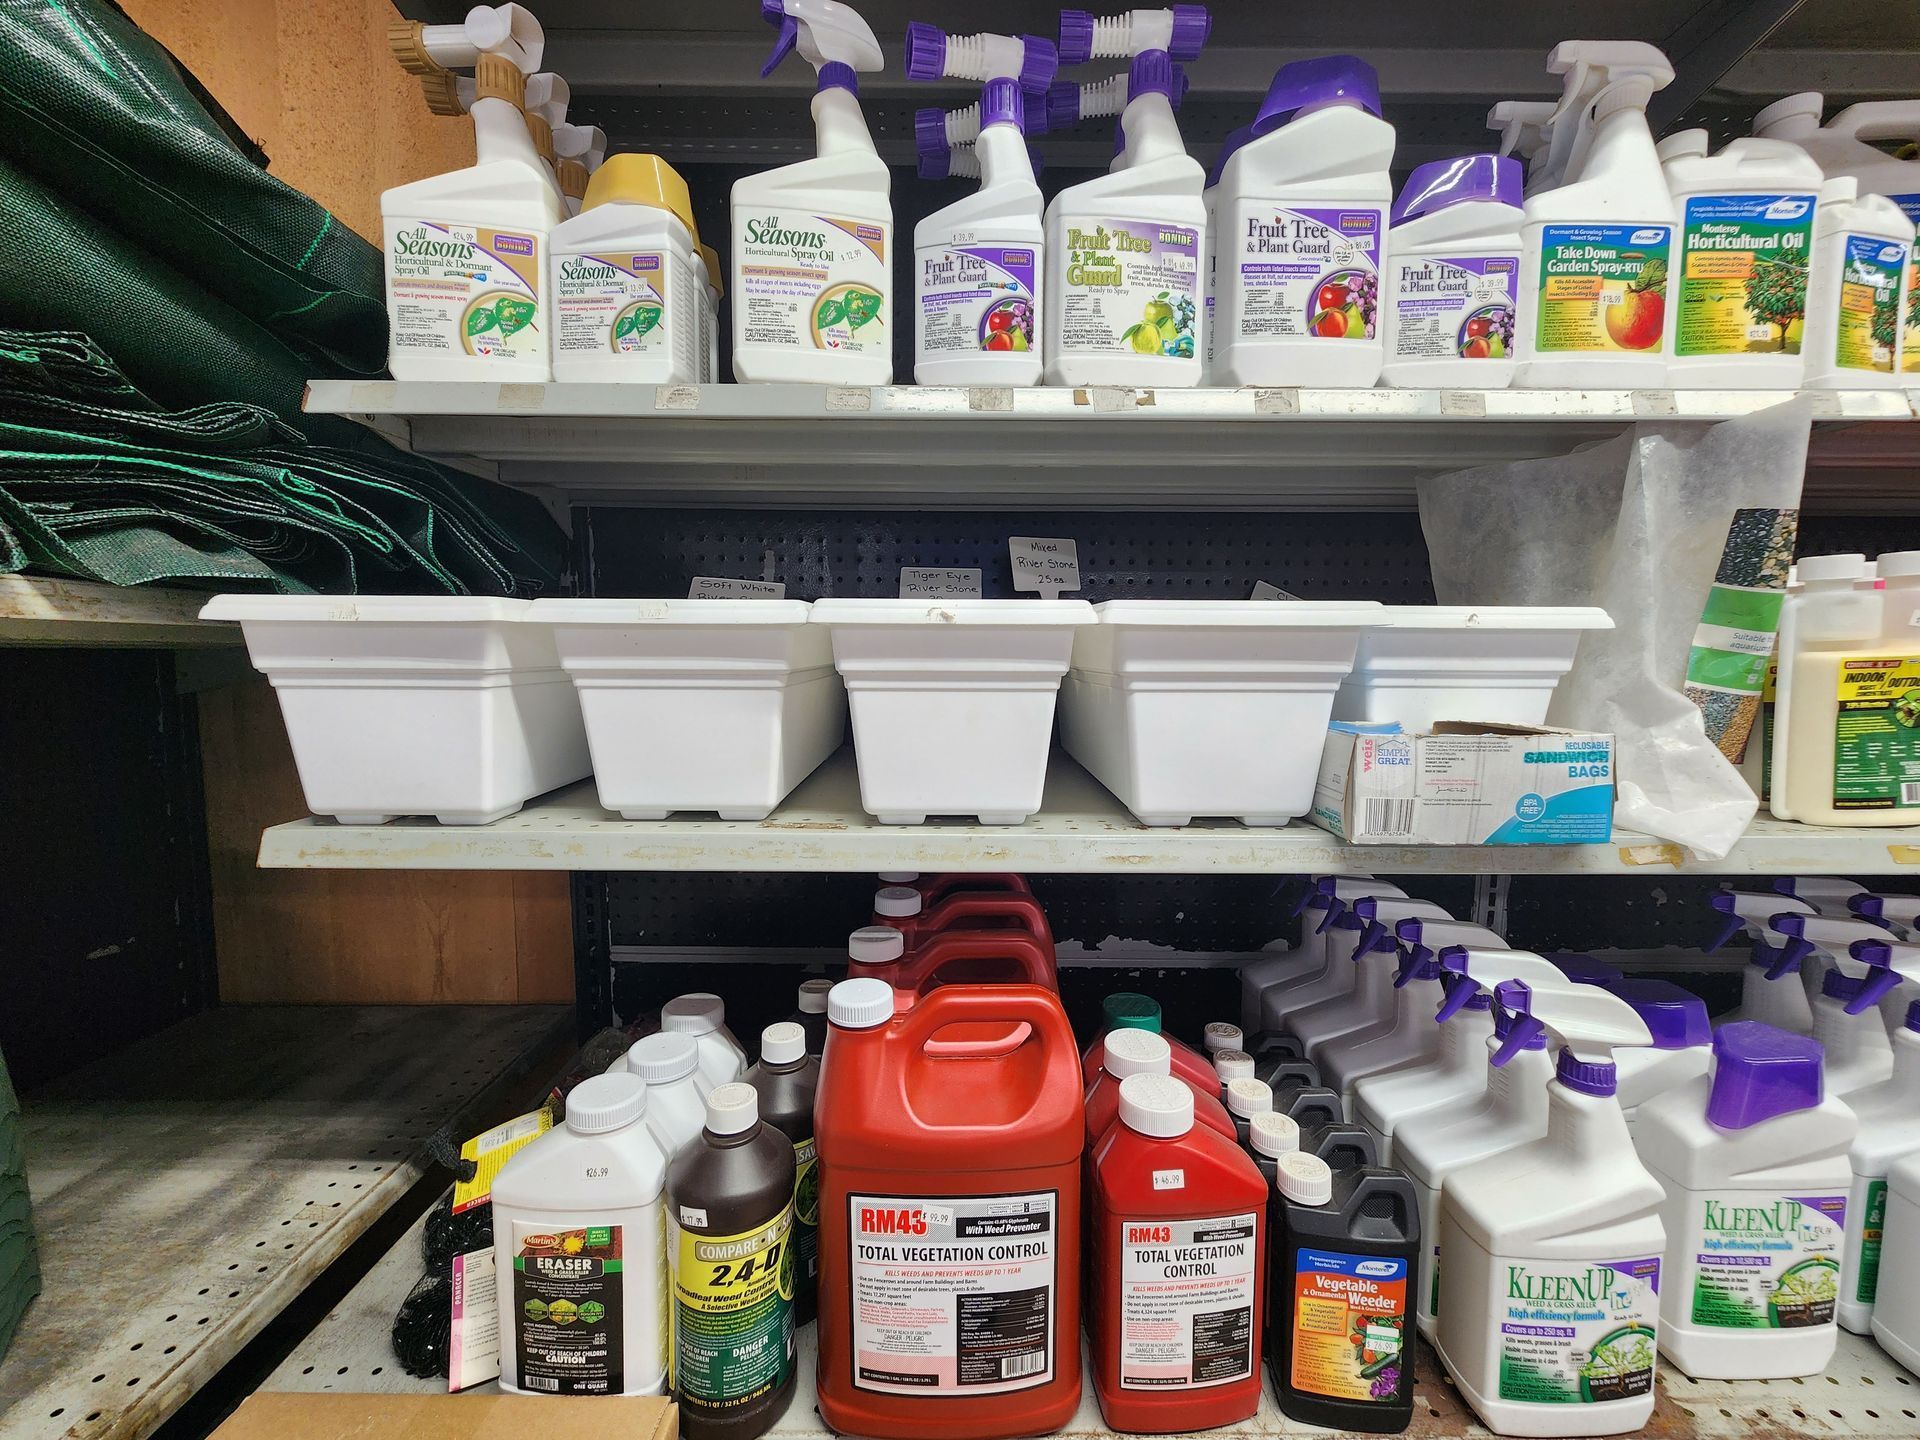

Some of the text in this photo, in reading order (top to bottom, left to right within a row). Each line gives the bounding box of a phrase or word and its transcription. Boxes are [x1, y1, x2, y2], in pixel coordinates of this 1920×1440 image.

[762, 216, 778, 228] All
[1248, 218, 1329, 239] Fruit Tree
[411, 228, 426, 239] All
[745, 219, 826, 249] Seasons
[1702, 223, 1741, 235] Monterey
[454, 232, 474, 242] $24.99
[1067, 228, 1152, 252] Fruit Tree
[1159, 232, 1193, 247] BONIDE
[1687, 233, 1804, 249] Horticultural Oil
[394, 231, 475, 259] Seasons
[1246, 239, 1330, 254] & Plant Guard
[746, 248, 834, 262] Horticultural Spray Oil
[1071, 251, 1116, 267] & Plant
[1556, 246, 1616, 259] Take Down
[395, 255, 444, 266] Horticultural
[456, 260, 492, 271] Dormant
[572, 258, 583, 267] All
[925, 255, 986, 275] Fruit Tree
[1547, 260, 1644, 275] Garden Spray-RTU
[395, 266, 429, 277] Spray Oil
[560, 261, 616, 280] Seasons
[1067, 263, 1122, 287] Guard
[1401, 265, 1467, 280] Fruit Tree
[924, 270, 987, 286] & Plant Guard
[1113, 288, 1129, 296] Spray
[1410, 281, 1435, 292] Plant
[1438, 279, 1468, 291] Guard
[560, 288, 575, 297] Spray
[1876, 289, 1890, 301] Oil
[1031, 543, 1057, 552] Mixed
[1016, 557, 1076, 569] River Stone
[910, 571, 971, 582] Tiger Eye
[700, 580, 775, 592] Soft White
[907, 584, 979, 593] River Stone
[1733, 633, 1766, 642] Suitable
[1844, 672, 1886, 683] INDOOR
[1565, 741, 1610, 750] RECLOSABLE
[1364, 739, 1373, 773] weis
[1377, 749, 1410, 757] SIMPLY
[1524, 751, 1609, 764] SANDWICH
[1568, 765, 1609, 778] BAGS
[586, 1168, 608, 1178] $26.99
[1161, 1175, 1180, 1184] 46.99
[861, 1208, 927, 1235] RM43
[929, 1213, 949, 1223] 99.99
[965, 1222, 1041, 1235] With Weed Preventer
[1129, 1227, 1171, 1243] RM43
[700, 1238, 758, 1259] COMPARE
[858, 1241, 1048, 1262] TOTAL VEGETATION CONTROL
[1135, 1243, 1244, 1264] TOTAL VEGETATION
[537, 1258, 592, 1270] ERASER
[708, 1242, 782, 1288] 2,4-D
[1309, 1256, 1346, 1265] Preemergence
[1315, 1261, 1340, 1269] Herbicide
[985, 1268, 993, 1276] UP
[1007, 1267, 1021, 1275] YEAR
[1164, 1263, 1217, 1279] CONTROL
[676, 1275, 776, 1302] Broadleaf Weed Control
[1316, 1275, 1378, 1294] Vegetable
[1310, 1290, 1346, 1300] Ornamental
[1348, 1292, 1397, 1309] Weeder
[1526, 1300, 1545, 1308] WEED
[1554, 1301, 1575, 1309] GRASS
[1508, 1307, 1606, 1323] high efficiency formula
[1505, 1324, 1526, 1335] Covers
[1529, 1327, 1536, 1336] up
[1537, 1327, 1543, 1335] to
[1544, 1327, 1556, 1336] 250
[1557, 1328, 1566, 1337] sq.
[732, 1335, 768, 1357] DANGER
[1374, 1343, 1393, 1351] 26.99
[546, 1355, 586, 1363] CAUTION
[740, 1348, 762, 1362] PELIGRO
